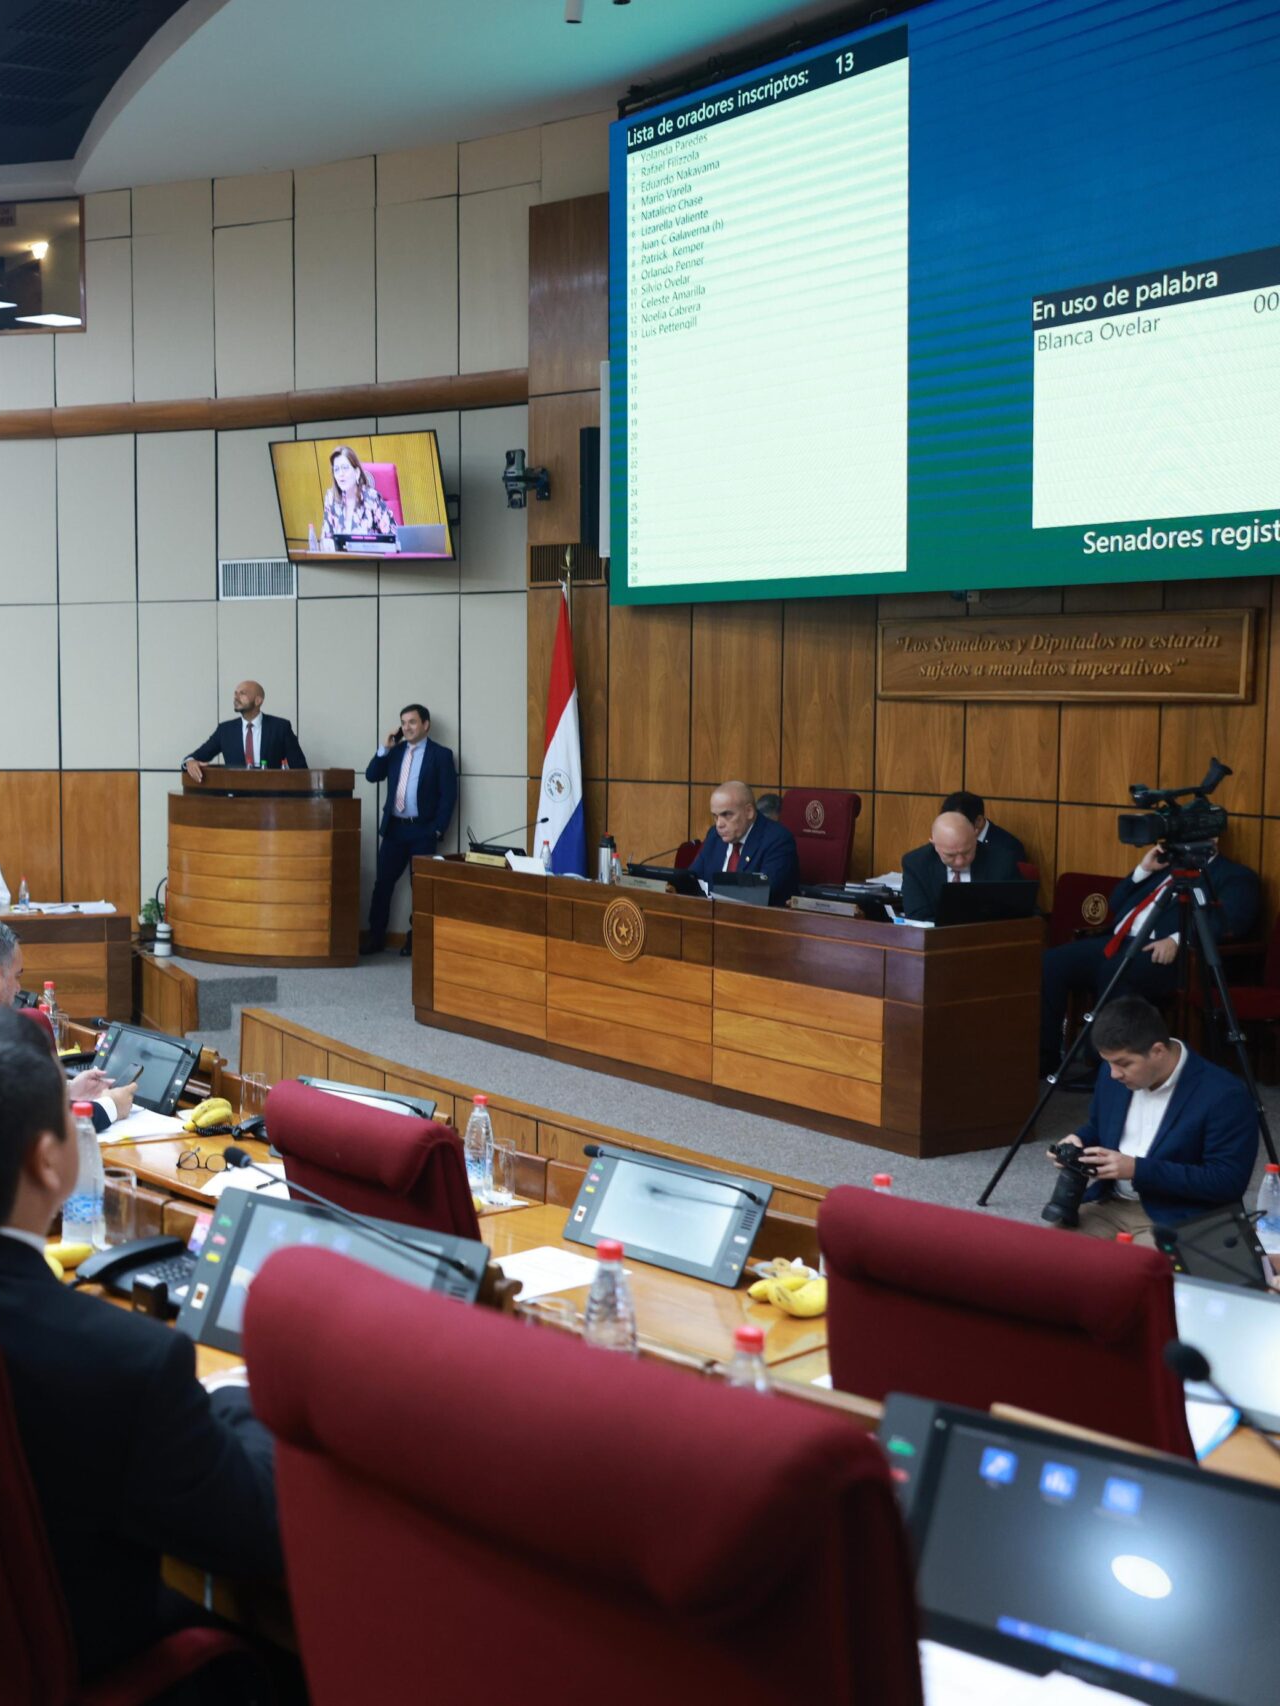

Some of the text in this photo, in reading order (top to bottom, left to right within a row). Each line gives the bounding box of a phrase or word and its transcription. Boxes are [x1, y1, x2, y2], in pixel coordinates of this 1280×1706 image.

[627, 52, 854, 147] Lista de oradores inscriptos: 13
[676, 134, 707, 151] Paredes
[641, 162, 665, 176] Rafael
[641, 174, 674, 192] Eduardo
[641, 193, 664, 206] Mario
[666, 184, 692, 199] Varela
[641, 204, 676, 220] Natalicio
[678, 195, 703, 210] Chase
[641, 220, 672, 236] Lizarella
[675, 209, 708, 226] Valiente
[641, 238, 659, 252] Juan
[669, 225, 710, 242] Galaverna
[641, 250, 667, 265] Patrick
[673, 241, 704, 257] Kemper
[641, 263, 673, 280] Orlando
[676, 257, 704, 271] Penner
[641, 281, 662, 295] Silvio
[664, 274, 690, 288] Ovelar
[1033, 270, 1218, 321] En uso de palabra
[641, 294, 670, 308] Celeste
[672, 285, 705, 301] Amarilla
[669, 303, 701, 317] Cabrera
[641, 327, 656, 338] Luis
[1038, 329, 1093, 351] Blanca
[1100, 317, 1160, 341] Ovelar
[1083, 527, 1203, 554] Senadores
[934, 635, 1011, 652] Senadores
[1015, 639, 1025, 655] y
[1030, 632, 1116, 654] Diputados
[1120, 636, 1145, 649] no
[1149, 626, 1220, 649] estarán
[920, 660, 969, 681] sujetos
[974, 664, 983, 676] a
[988, 659, 1066, 676] mandatos
